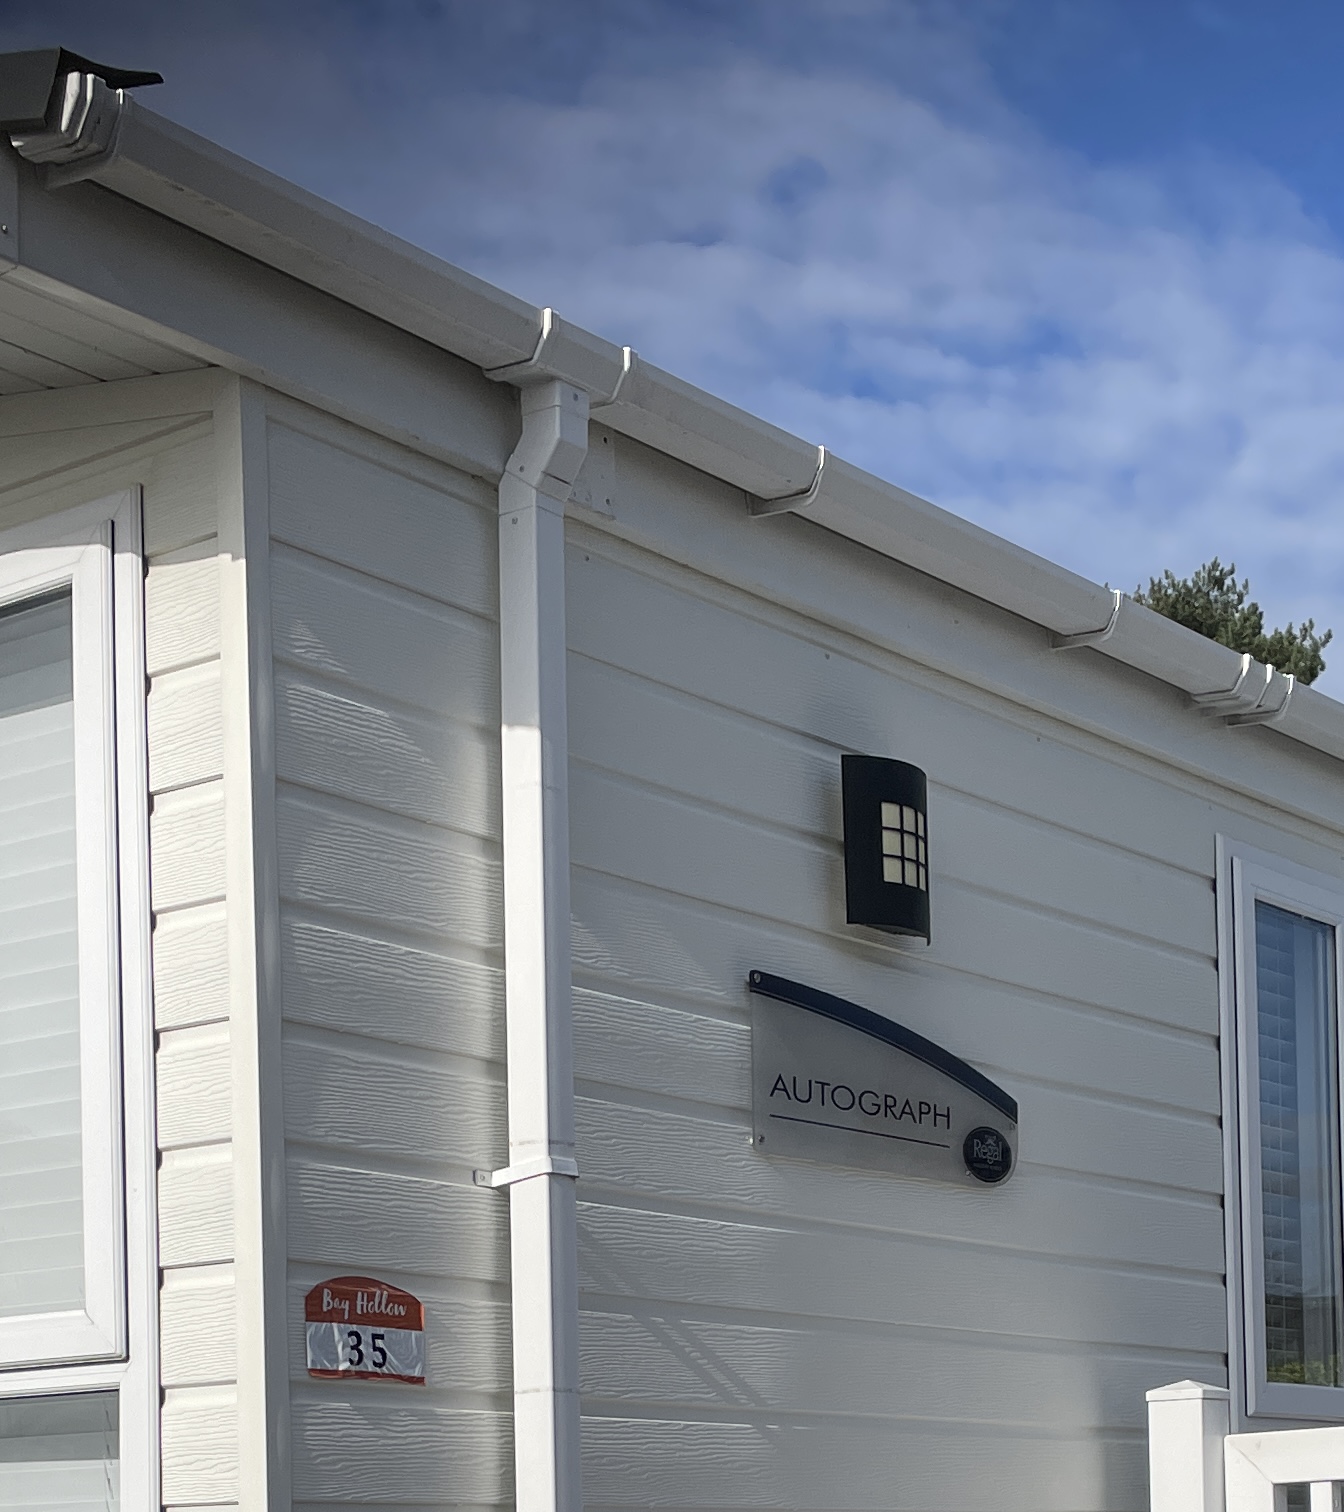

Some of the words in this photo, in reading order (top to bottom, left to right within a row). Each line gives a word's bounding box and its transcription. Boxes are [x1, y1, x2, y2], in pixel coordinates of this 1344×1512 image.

[769, 1073, 951, 1130] AUTOGRAPH
[973, 1138, 1003, 1164] Regal
[322, 1288, 350, 1320] Bay
[357, 1290, 407, 1317] Hollow
[347, 1330, 388, 1369] 35
